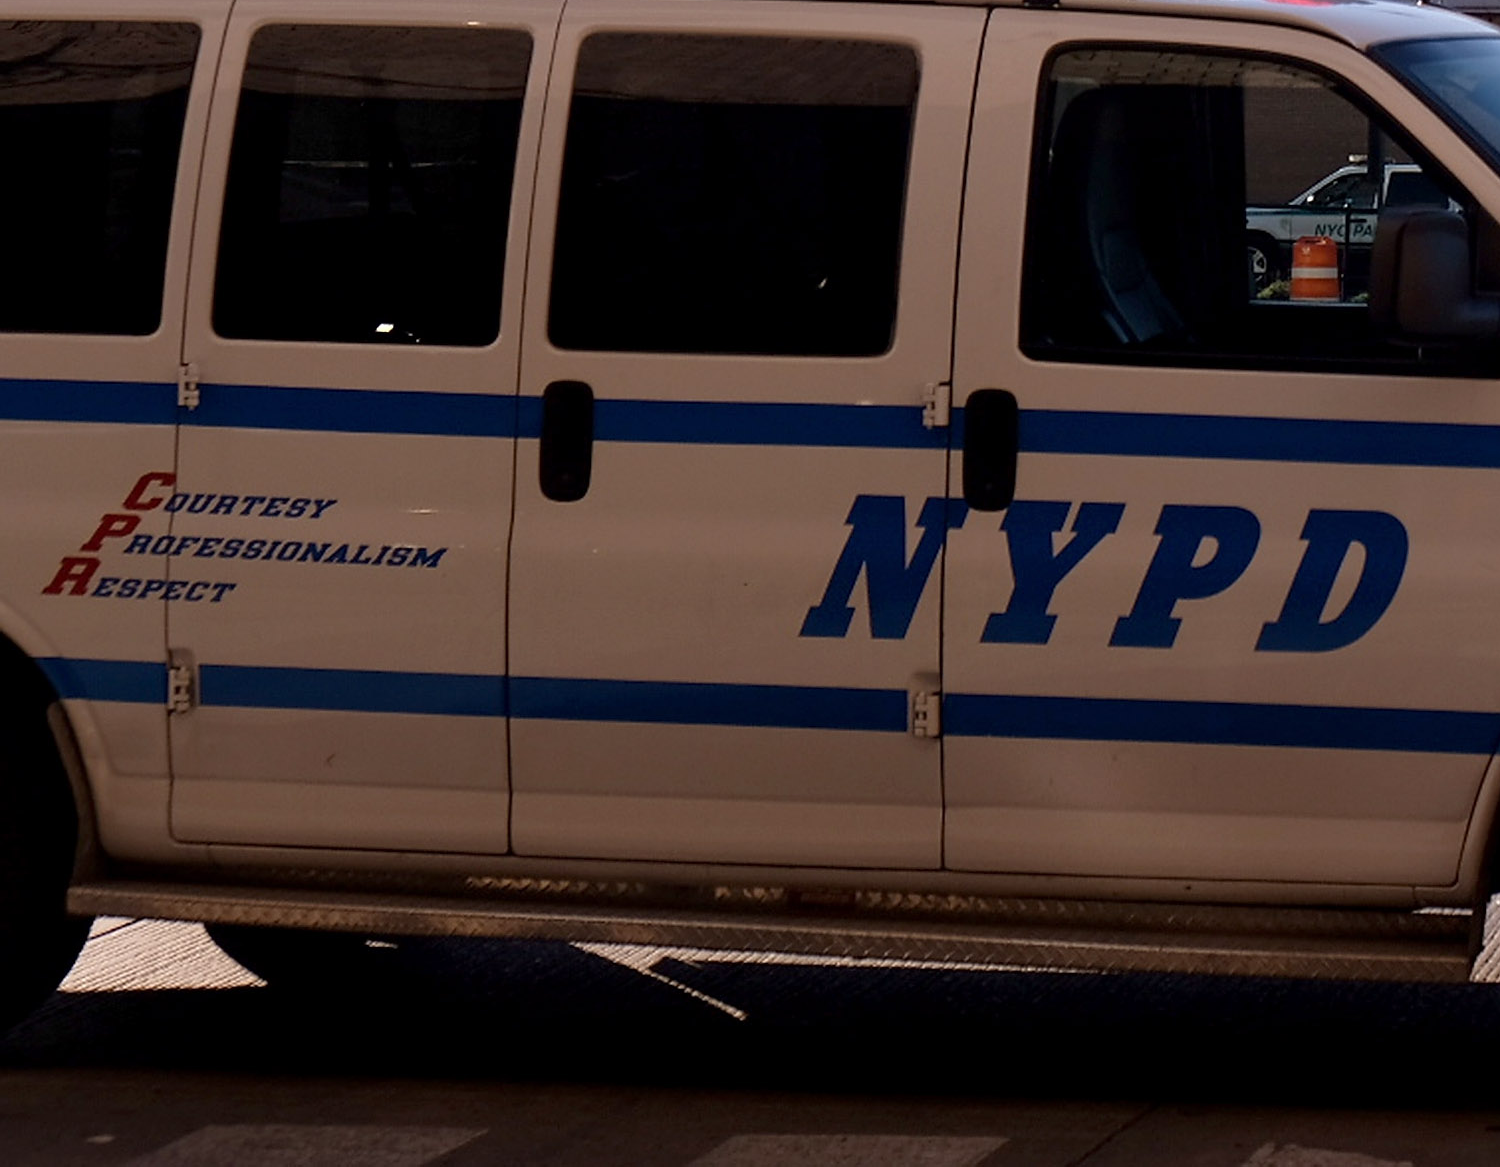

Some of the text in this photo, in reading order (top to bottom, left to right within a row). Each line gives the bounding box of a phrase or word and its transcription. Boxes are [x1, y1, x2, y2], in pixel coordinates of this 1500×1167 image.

[1315, 224, 1345, 237] NYC
[122, 471, 337, 519] COURTESY
[80, 514, 447, 568] PROFESSIONALISM
[42, 557, 237, 603] RESPECT
[800, 495, 1409, 652] NYPD
